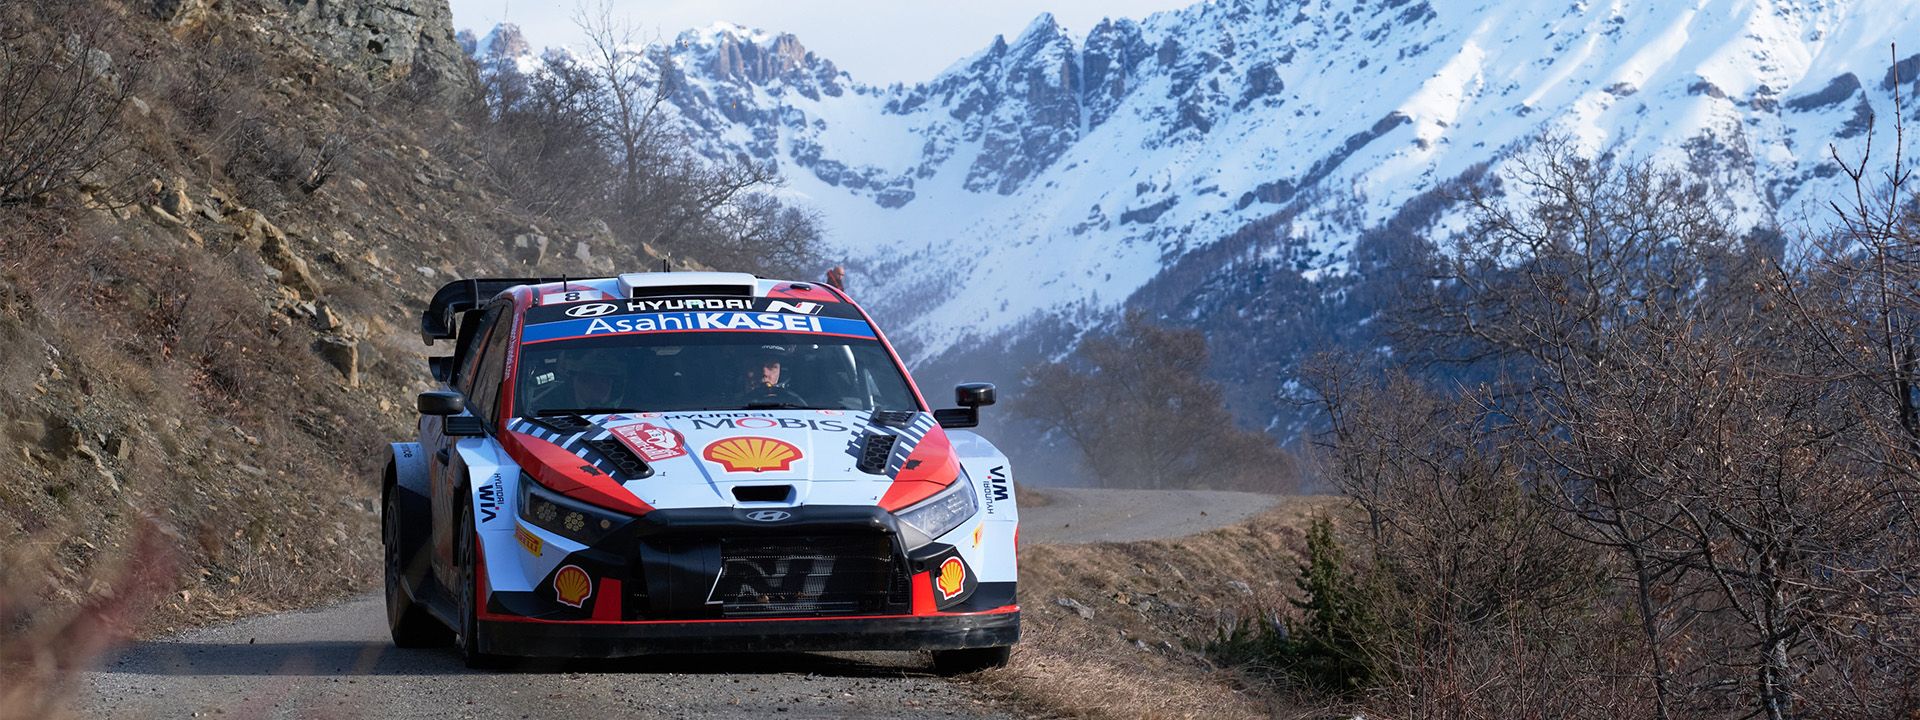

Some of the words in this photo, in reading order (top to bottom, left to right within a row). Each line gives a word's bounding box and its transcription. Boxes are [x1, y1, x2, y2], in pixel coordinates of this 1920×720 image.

[564, 291, 581, 302] 8
[627, 299, 753, 312] HYUNDAI
[585, 312, 823, 335] AsahiKASEI
[691, 417, 848, 432] MOBIS
[494, 472, 505, 505] HYUNDAI
[990, 465, 1009, 501] WIA
[478, 484, 496, 523] WIA
[982, 480, 994, 515] HYUNDAI
